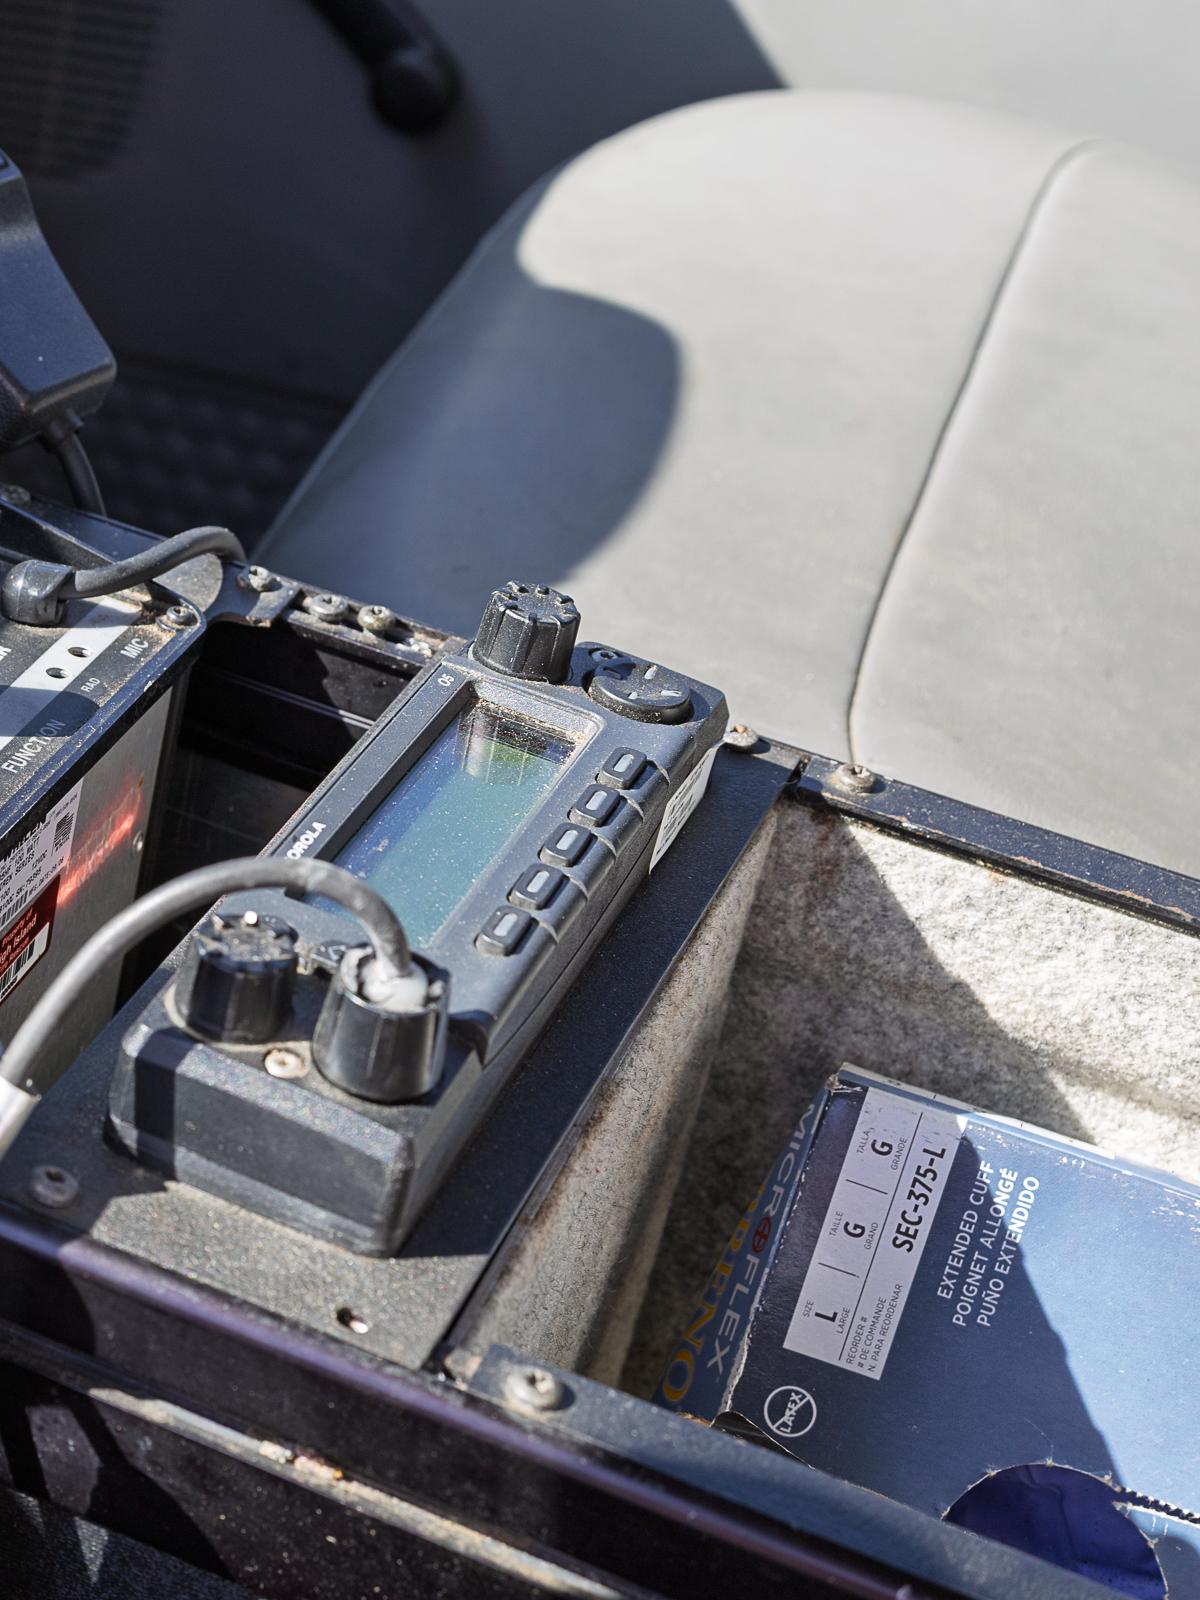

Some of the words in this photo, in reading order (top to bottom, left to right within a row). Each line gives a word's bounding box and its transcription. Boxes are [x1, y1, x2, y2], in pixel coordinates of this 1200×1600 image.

[120, 638, 149, 659] MIC
[81, 677, 100, 693] RAD
[1, 719, 67, 774] FUNCTION
[284, 822, 327, 860] OROLA
[13, 913, 37, 948] Island
[856, 1129, 871, 1154] TALLA
[870, 1139, 893, 1156] G
[891, 1137, 907, 1171] GRANDE
[891, 1147, 946, 1254] SEC-375-L
[829, 1210, 844, 1237] TAILLE
[843, 1221, 866, 1239] G
[864, 1222, 879, 1250] GRAND
[937, 1210, 979, 1299] EXTENDED
[969, 1160, 994, 1205] CUFF
[952, 1251, 989, 1327] POIGNET
[979, 1167, 1019, 1249] ALLONGÉ
[976, 1278, 1004, 1327] PUÑO
[995, 1176, 1040, 1275] EXTENDIDO
[802, 1299, 814, 1318] SIZE
[814, 1311, 838, 1323] L
[836, 1307, 851, 1335] LARGE
[871, 1338, 884, 1362] PARA
[879, 1283, 903, 1337] REORDENAR
[846, 1323, 865, 1365] REORDER
[859, 1347, 869, 1361] DE
[864, 1296, 887, 1347] COMMANDE
